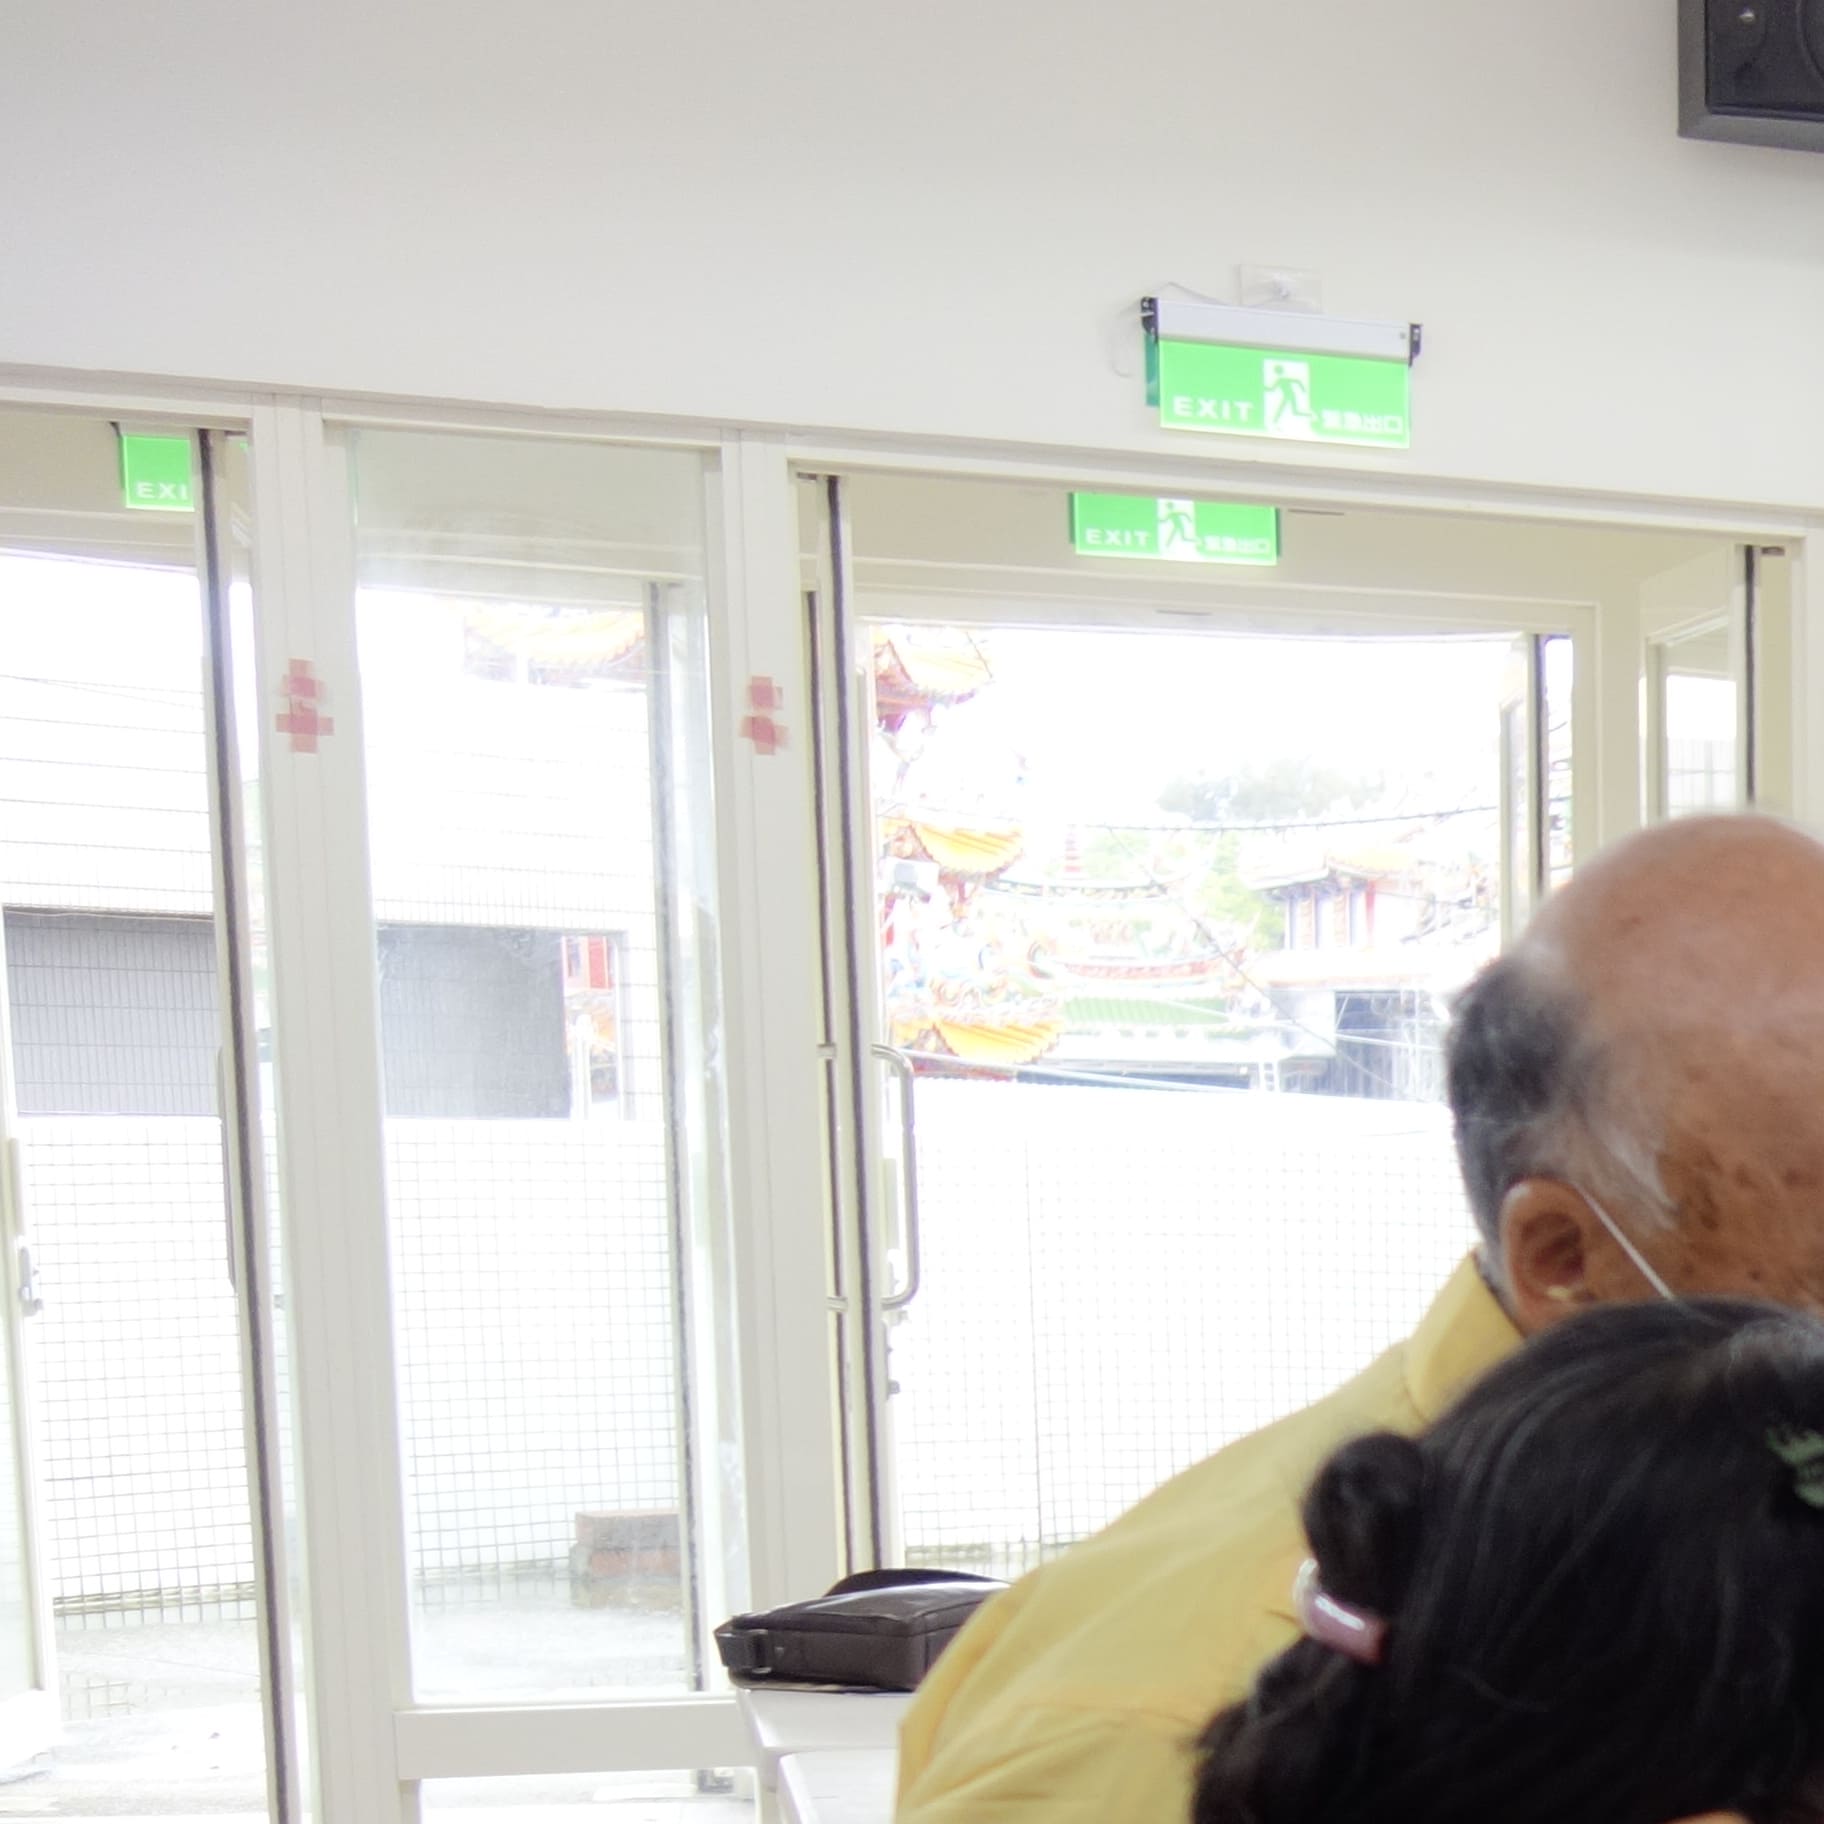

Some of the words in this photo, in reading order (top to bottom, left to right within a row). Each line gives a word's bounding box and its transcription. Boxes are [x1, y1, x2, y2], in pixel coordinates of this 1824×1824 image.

[1171, 395, 1254, 422] EXIT
[136, 482, 189, 501] EXI
[1085, 528, 1150, 548] EXIT
